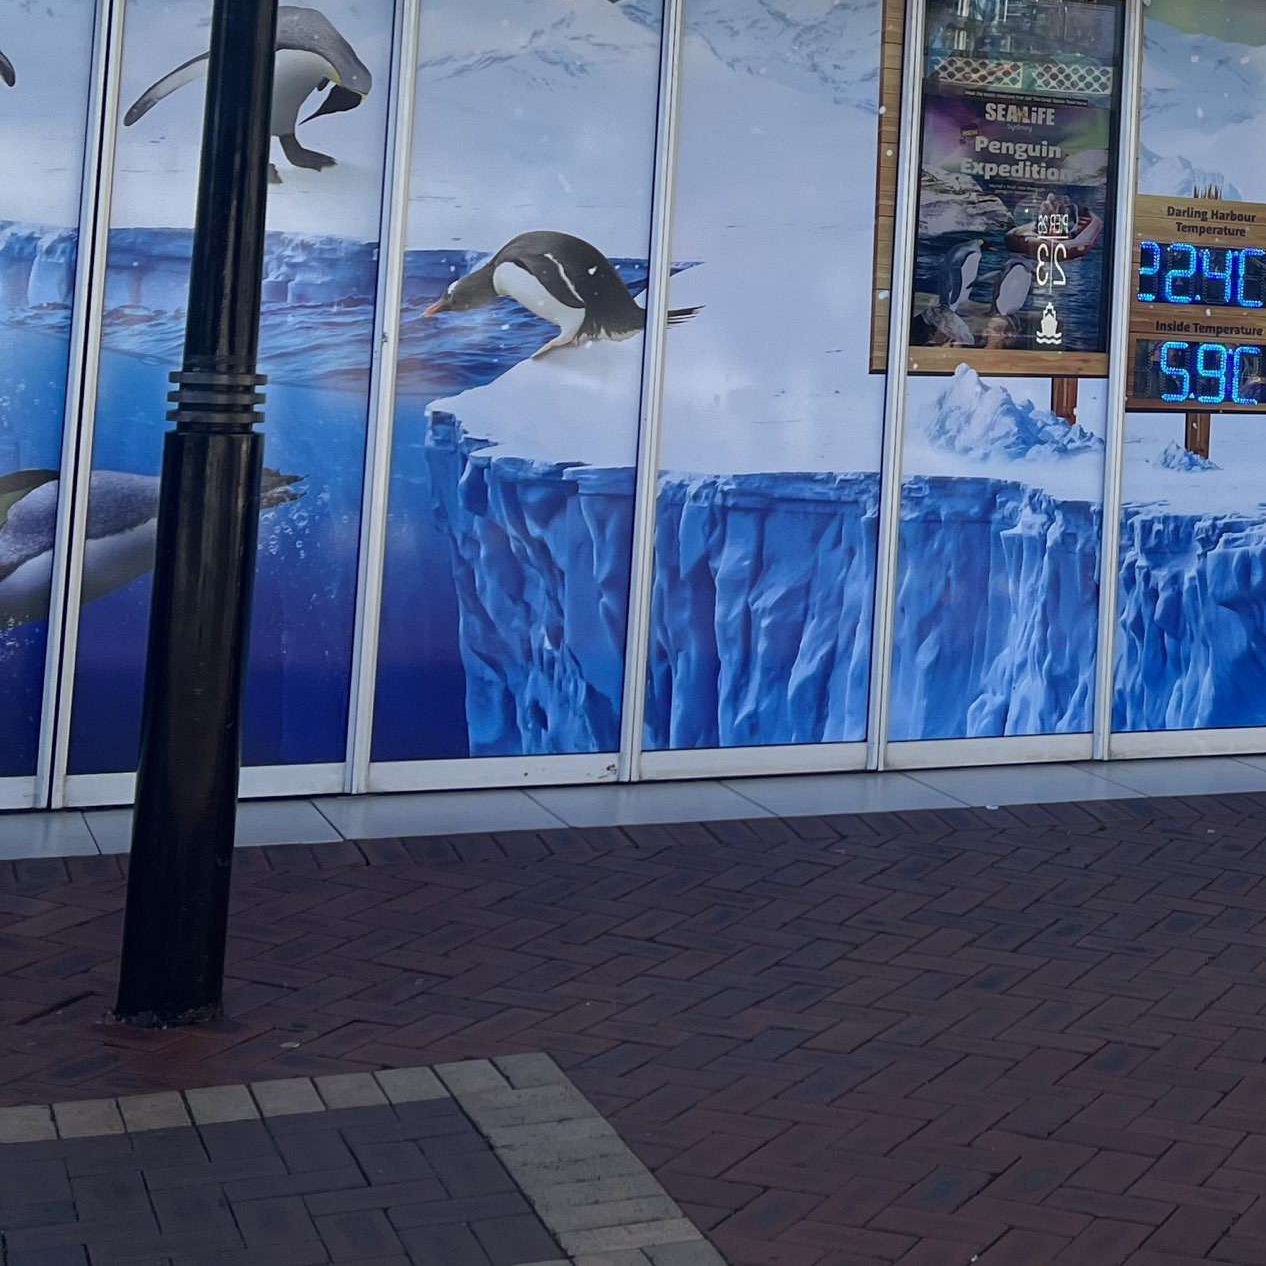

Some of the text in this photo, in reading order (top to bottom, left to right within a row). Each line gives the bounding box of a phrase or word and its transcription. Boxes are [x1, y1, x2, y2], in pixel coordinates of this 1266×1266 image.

[1006, 123, 1033, 133] Sydney
[975, 135, 1062, 160] Penguin
[960, 157, 1075, 181] Expedition
[1167, 205, 1257, 223] Darling Harbour
[1176, 222, 1246, 237] Temperature
[1155, 320, 1263, 337] Inside Temperature
